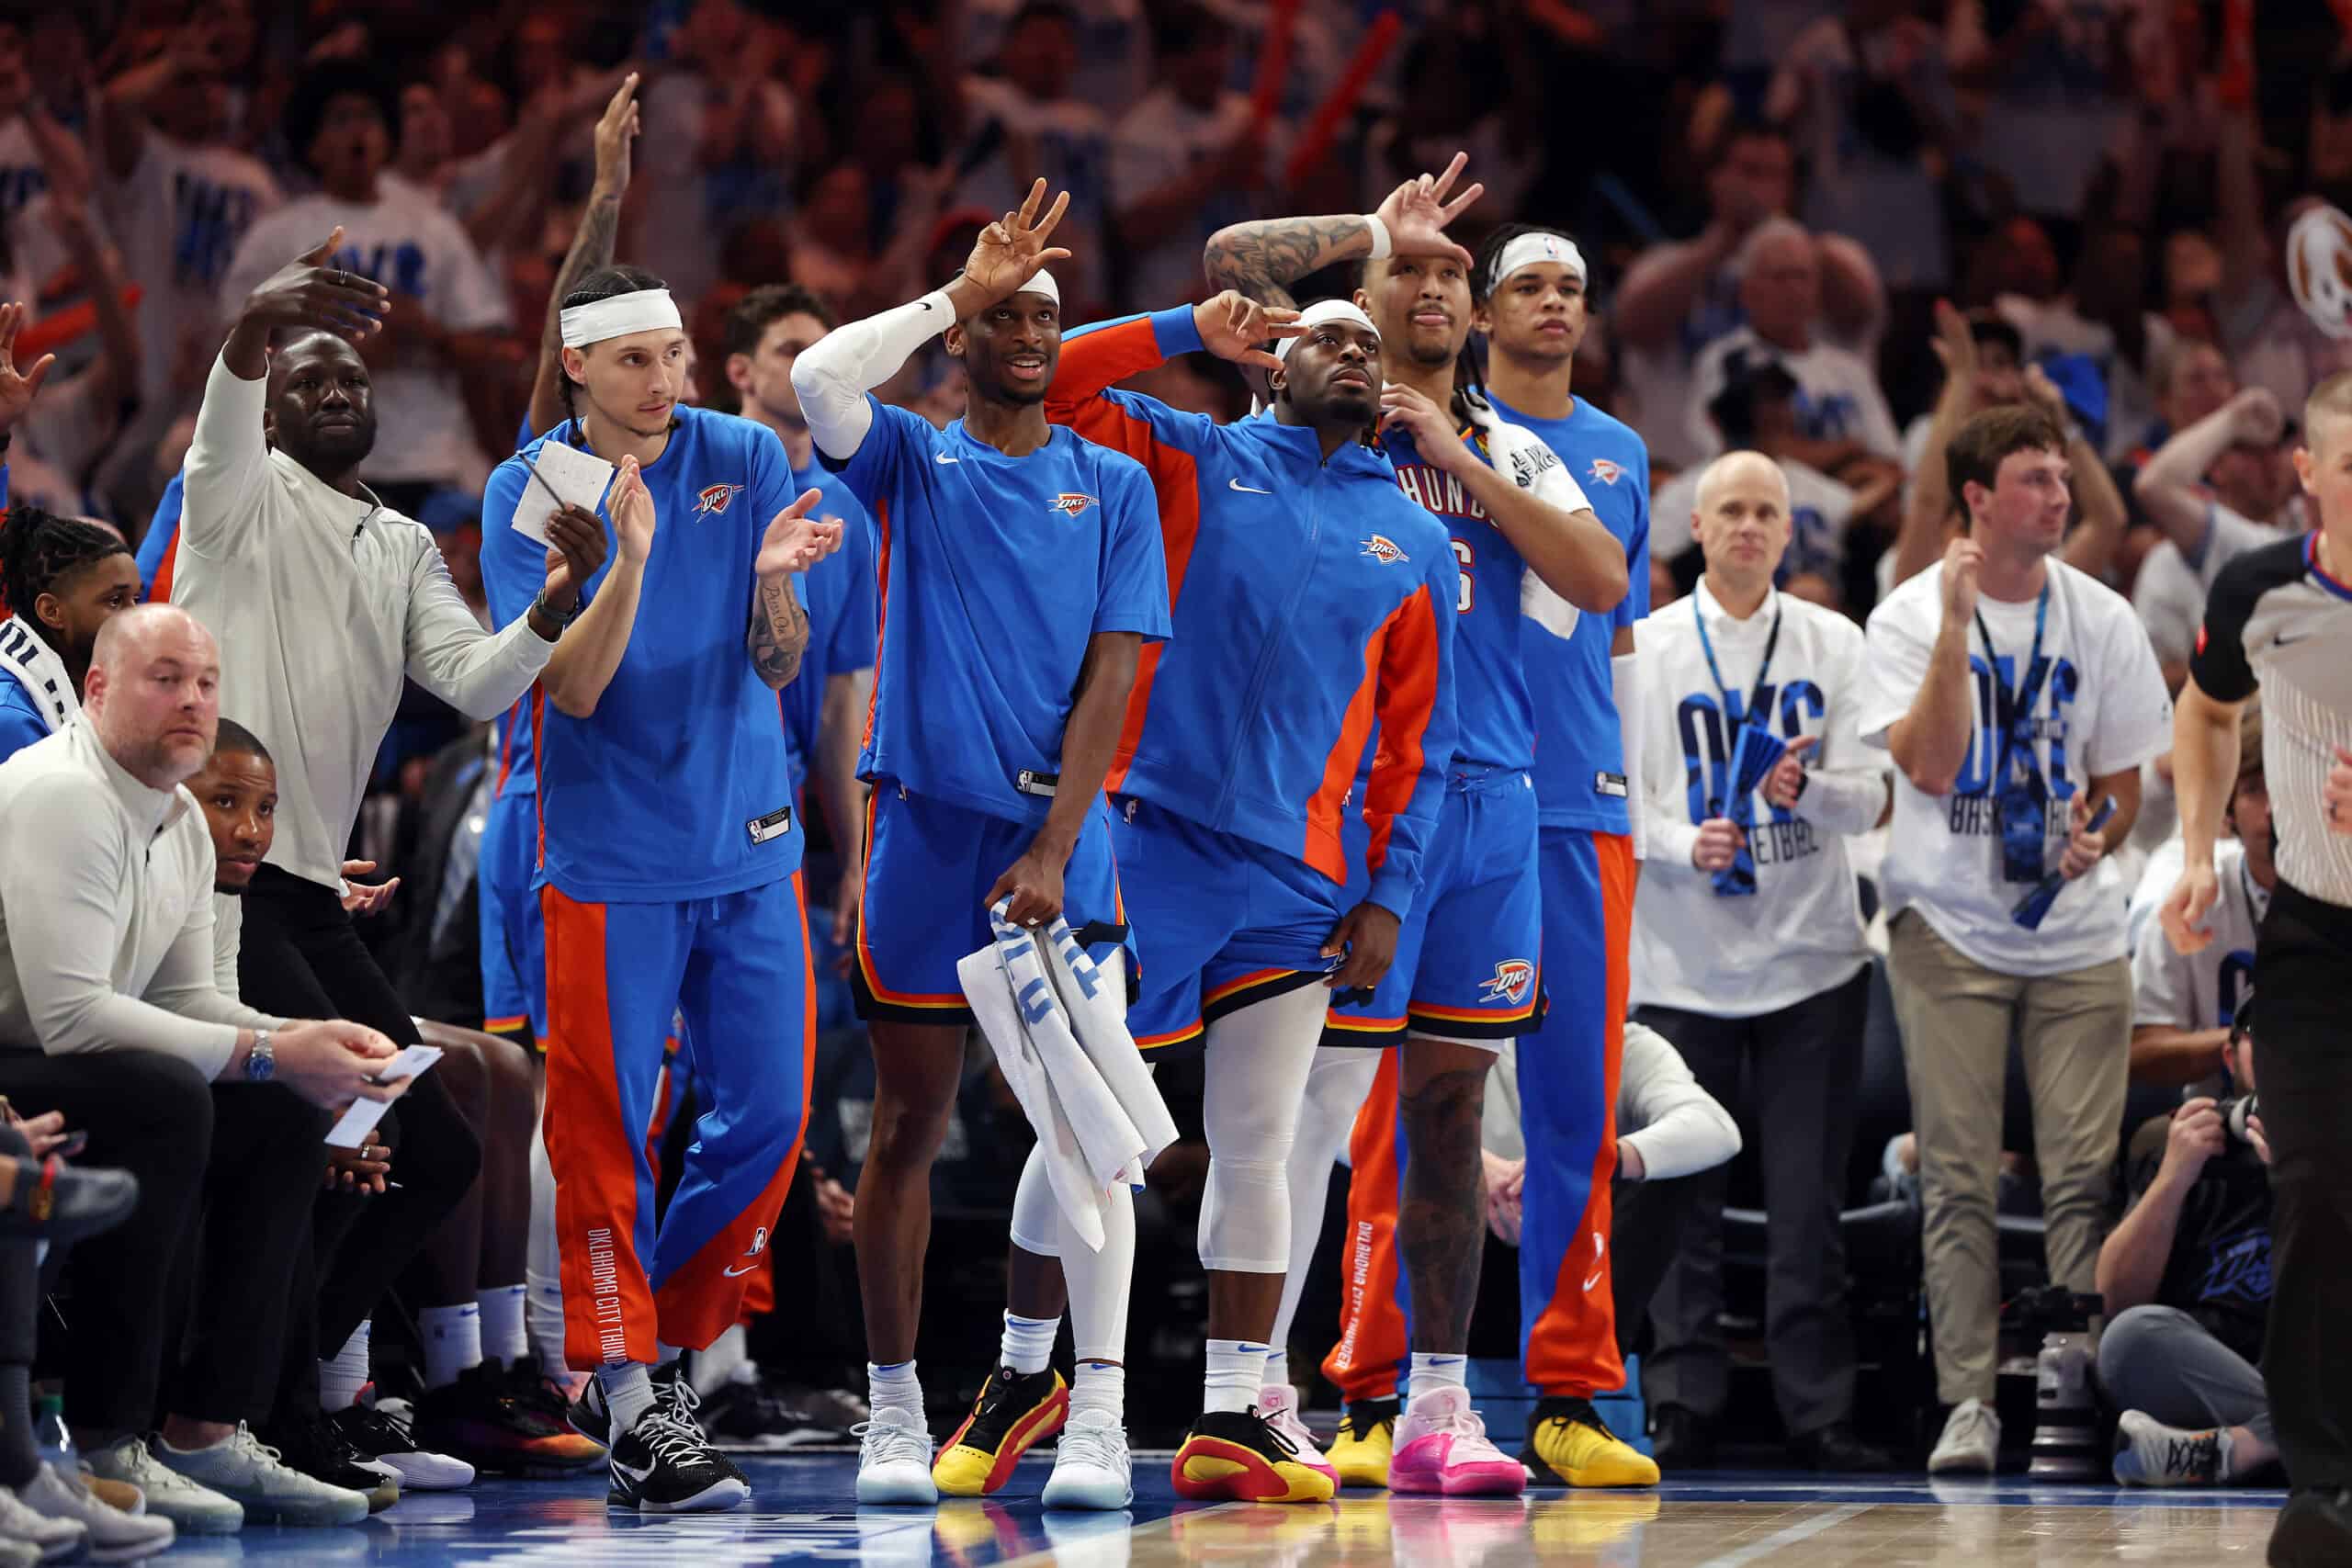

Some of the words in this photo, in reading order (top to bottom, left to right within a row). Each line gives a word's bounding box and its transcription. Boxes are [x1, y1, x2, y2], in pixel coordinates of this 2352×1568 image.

[702, 488, 728, 513] OKC
[1495, 969, 1528, 993] OKC
[587, 1227, 618, 1294] OKLAHOMA
[1352, 1220, 1373, 1285] OKLAHOMA
[595, 1296, 623, 1324] CITY
[1351, 1286, 1364, 1314] CITY
[600, 1325, 628, 1364] THUND
[1335, 1316, 1361, 1371] THUNDER
